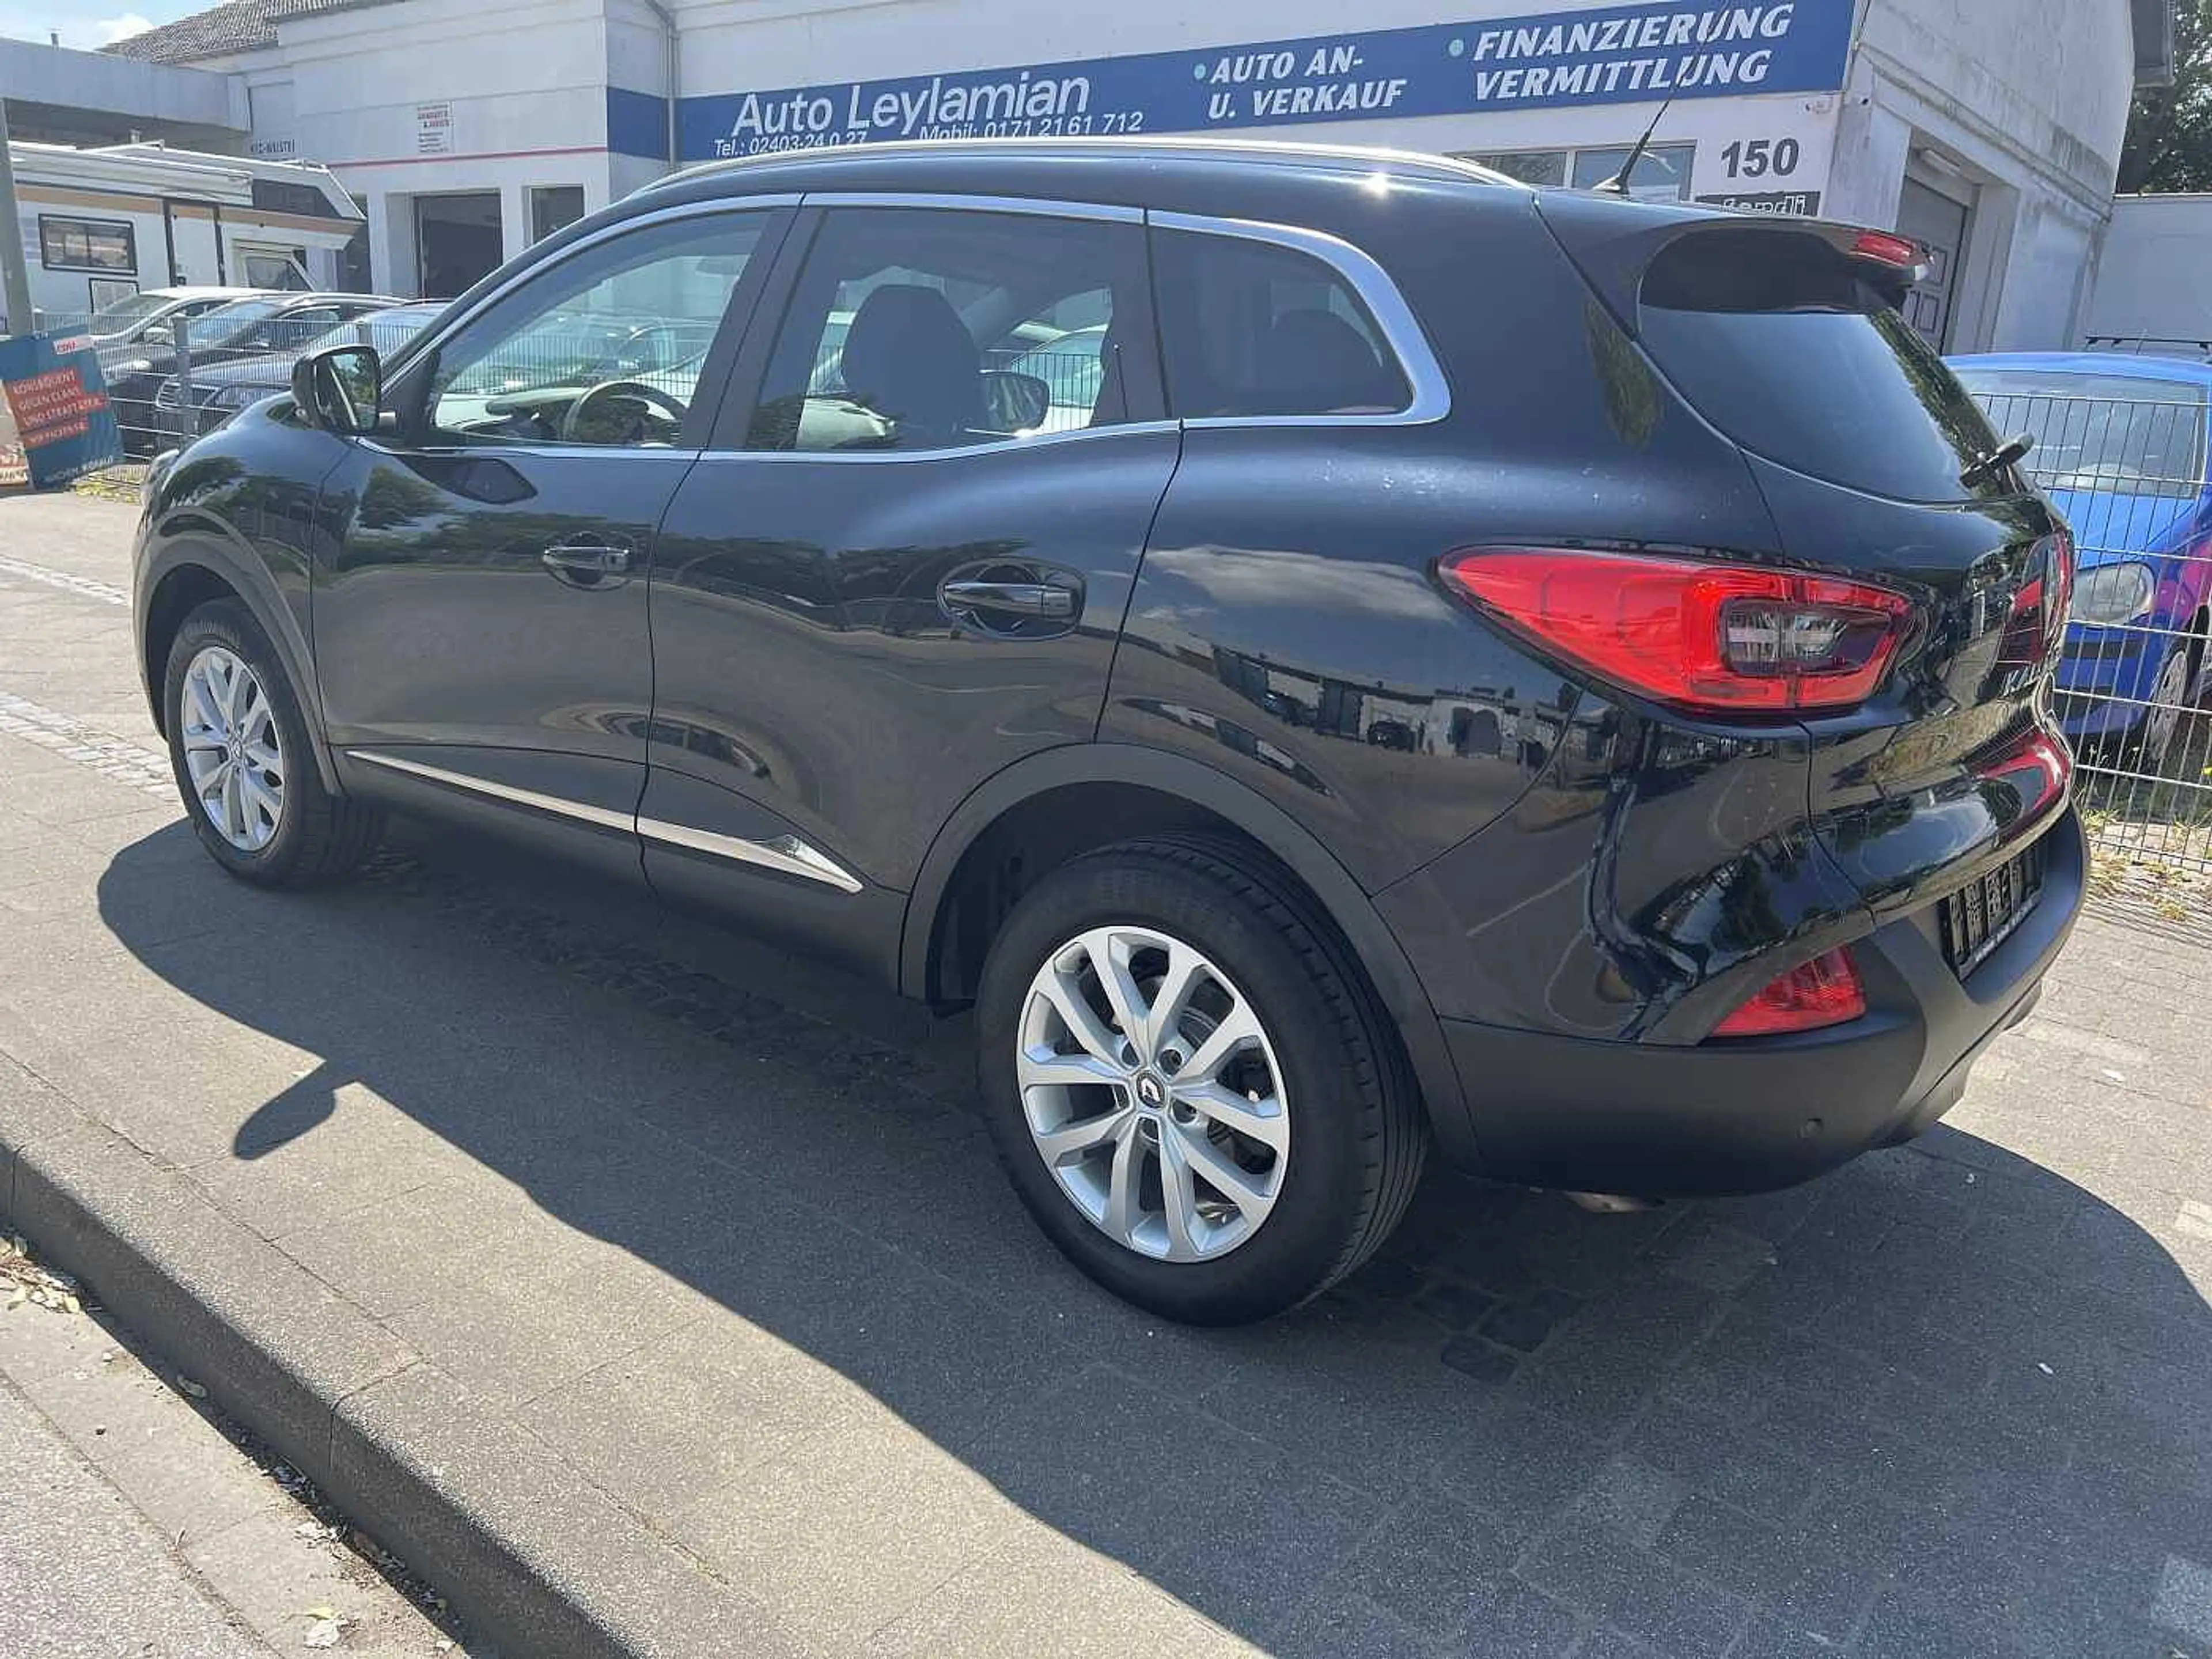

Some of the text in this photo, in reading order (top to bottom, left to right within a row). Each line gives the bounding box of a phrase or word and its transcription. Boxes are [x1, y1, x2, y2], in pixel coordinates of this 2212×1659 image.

[1473, 3, 1794, 60] FINANZIERUNG
[1210, 46, 1363, 84] AUTO AN-
[1476, 50, 1772, 100] VERMITTLUNG
[731, 70, 1090, 137] Auto Leylamian
[1209, 79, 1407, 119] U. VERKAUF
[1102, 111, 1143, 134] 712
[714, 138, 745, 157] Tel.:
[1721, 138, 1800, 179] 150
